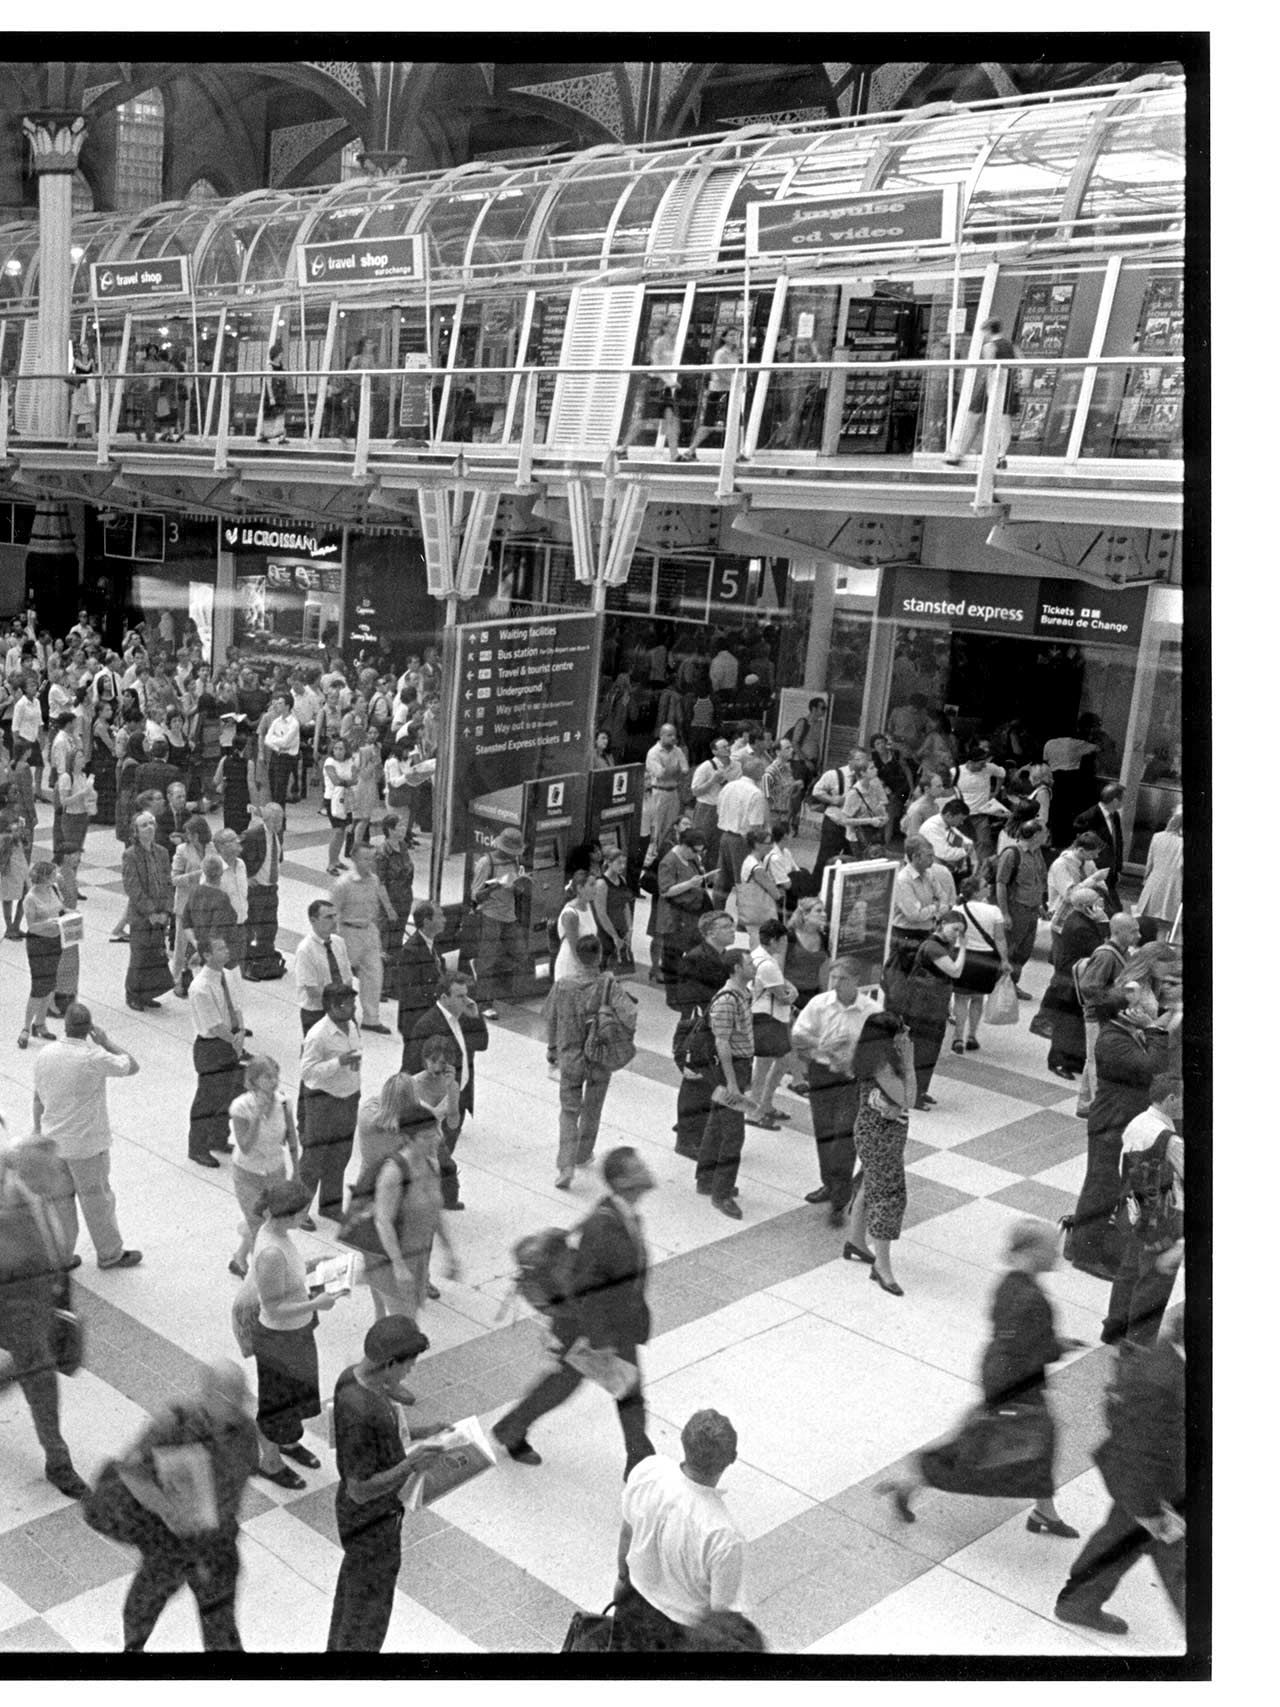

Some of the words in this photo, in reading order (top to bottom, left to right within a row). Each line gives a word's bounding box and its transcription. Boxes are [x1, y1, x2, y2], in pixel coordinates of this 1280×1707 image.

[792, 203, 905, 221] impulse
[830, 227, 904, 241] video
[328, 254, 356, 270] travel
[360, 253, 388, 268] shop
[116, 272, 139, 286] travel
[141, 271, 162, 284] shop
[169, 522, 179, 543] 3
[720, 569, 739, 598] 5
[903, 598, 965, 616] stansted
[967, 605, 1024, 622] express
[1042, 605, 1074, 616] Tickets
[1041, 615, 1073, 627] Bureau
[1076, 618, 1089, 628] de
[1091, 620, 1128, 632] Change
[500, 629, 528, 641] Waiting
[529, 626, 557, 637] facilities
[498, 649, 512, 660] Bus
[514, 647, 538, 659] station
[498, 667, 519, 678] Travel
[520, 666, 526, 675] &
[527, 664, 551, 675] tourist
[551, 661, 574, 671] centre
[496, 682, 543, 697] Underground
[496, 704, 512, 716] Way
[494, 723, 510, 734] Way
[475, 743, 507, 755] Stansted
[508, 738, 536, 751] Express
[537, 735, 560, 746] tickets
[474, 830, 497, 849] Tick
